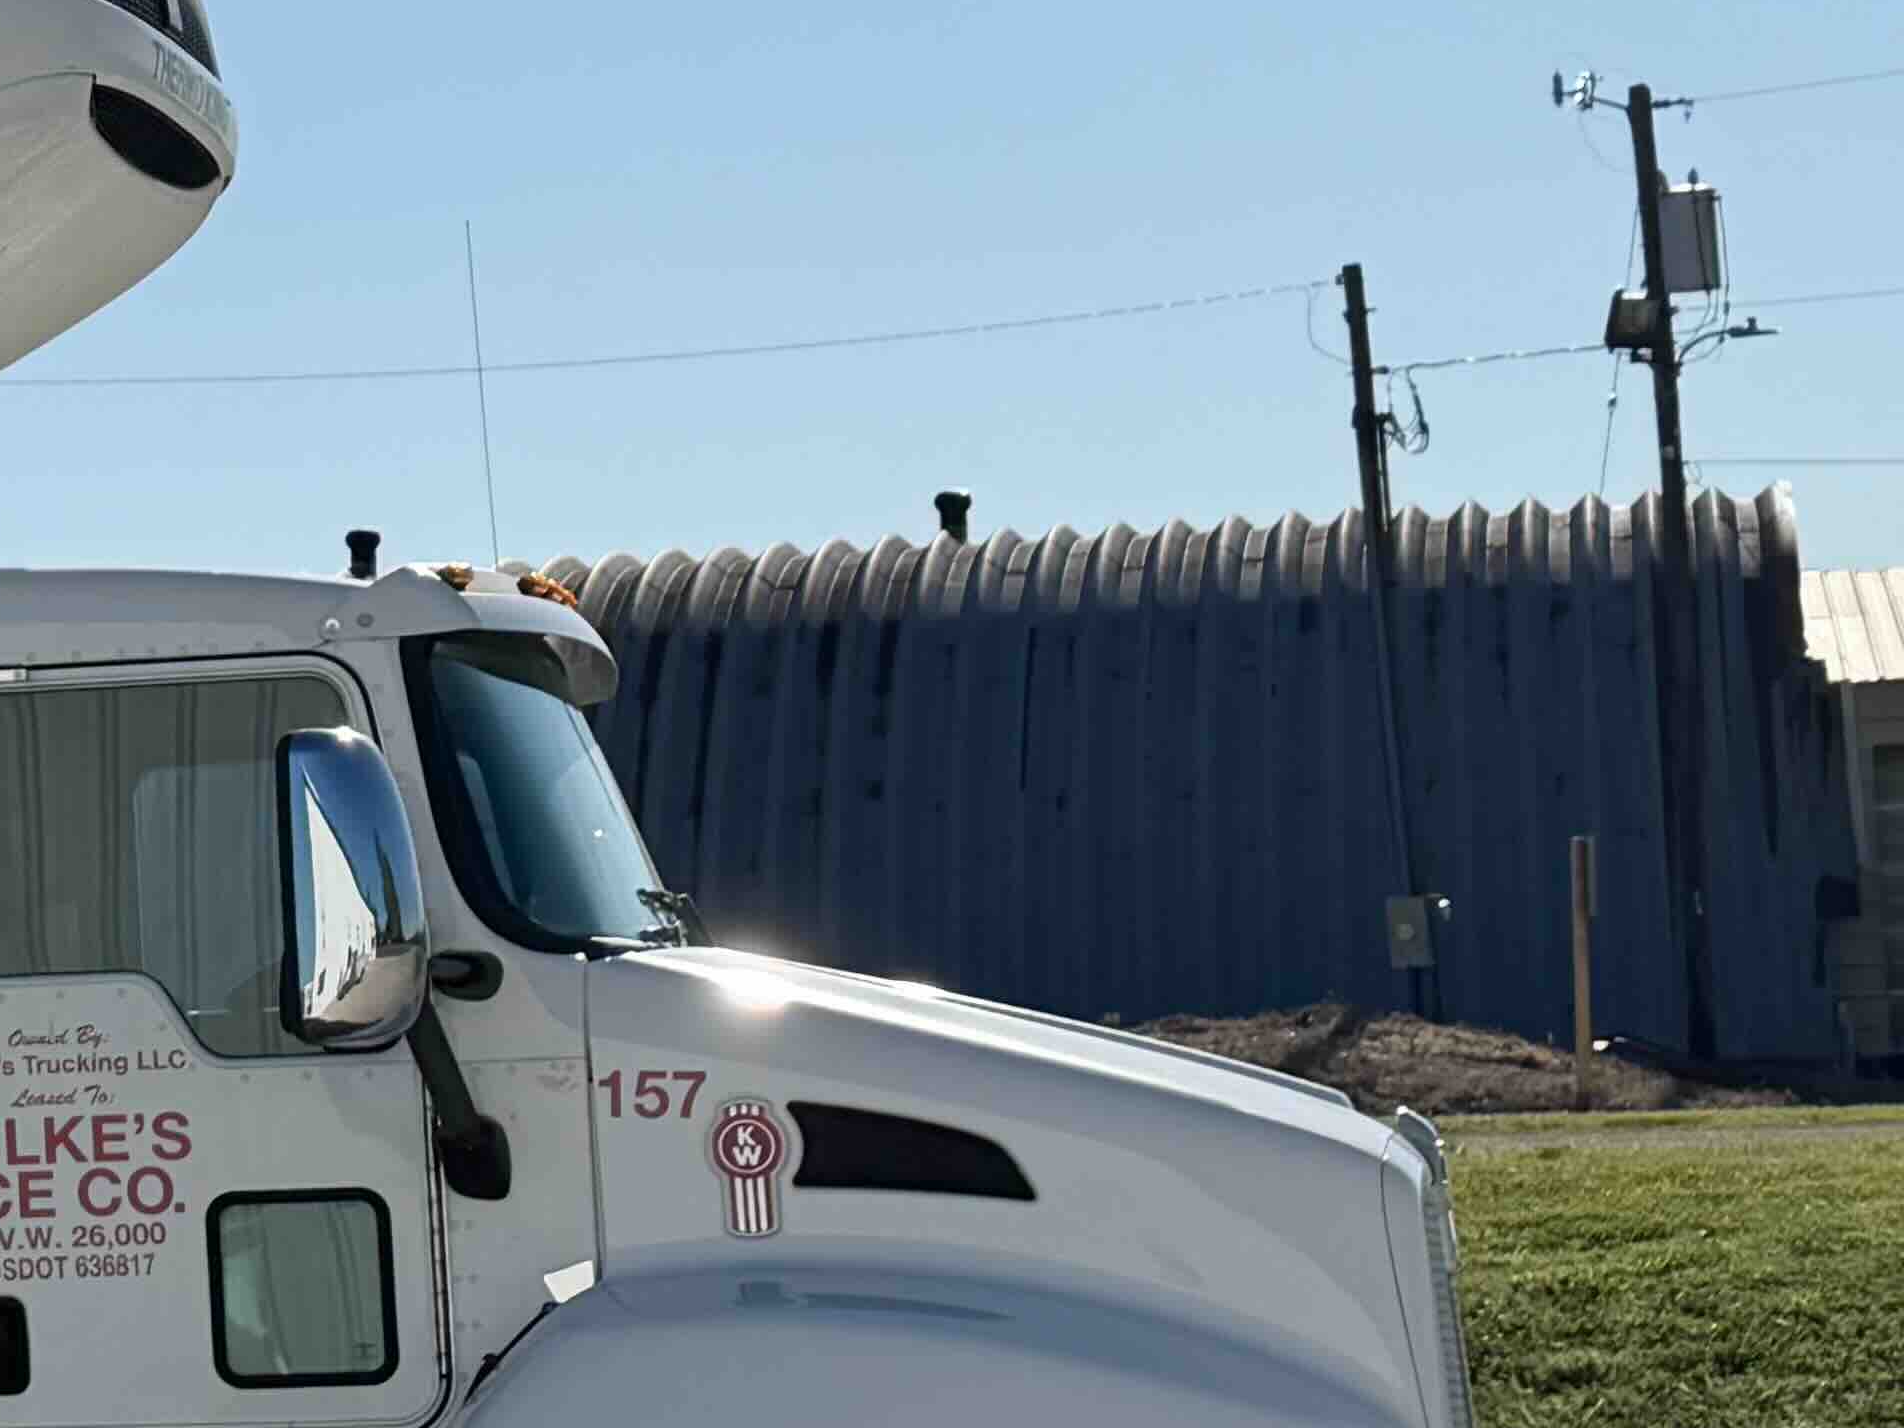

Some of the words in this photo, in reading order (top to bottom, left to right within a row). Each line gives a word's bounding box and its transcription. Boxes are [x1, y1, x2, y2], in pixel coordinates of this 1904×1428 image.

[22, 1053, 128, 1076] Trucking
[598, 1069, 707, 1118] 157
[78, 1167, 186, 1217] CO.
[71, 1222, 166, 1249] 26,000
[76, 1253, 155, 1278] 636817
